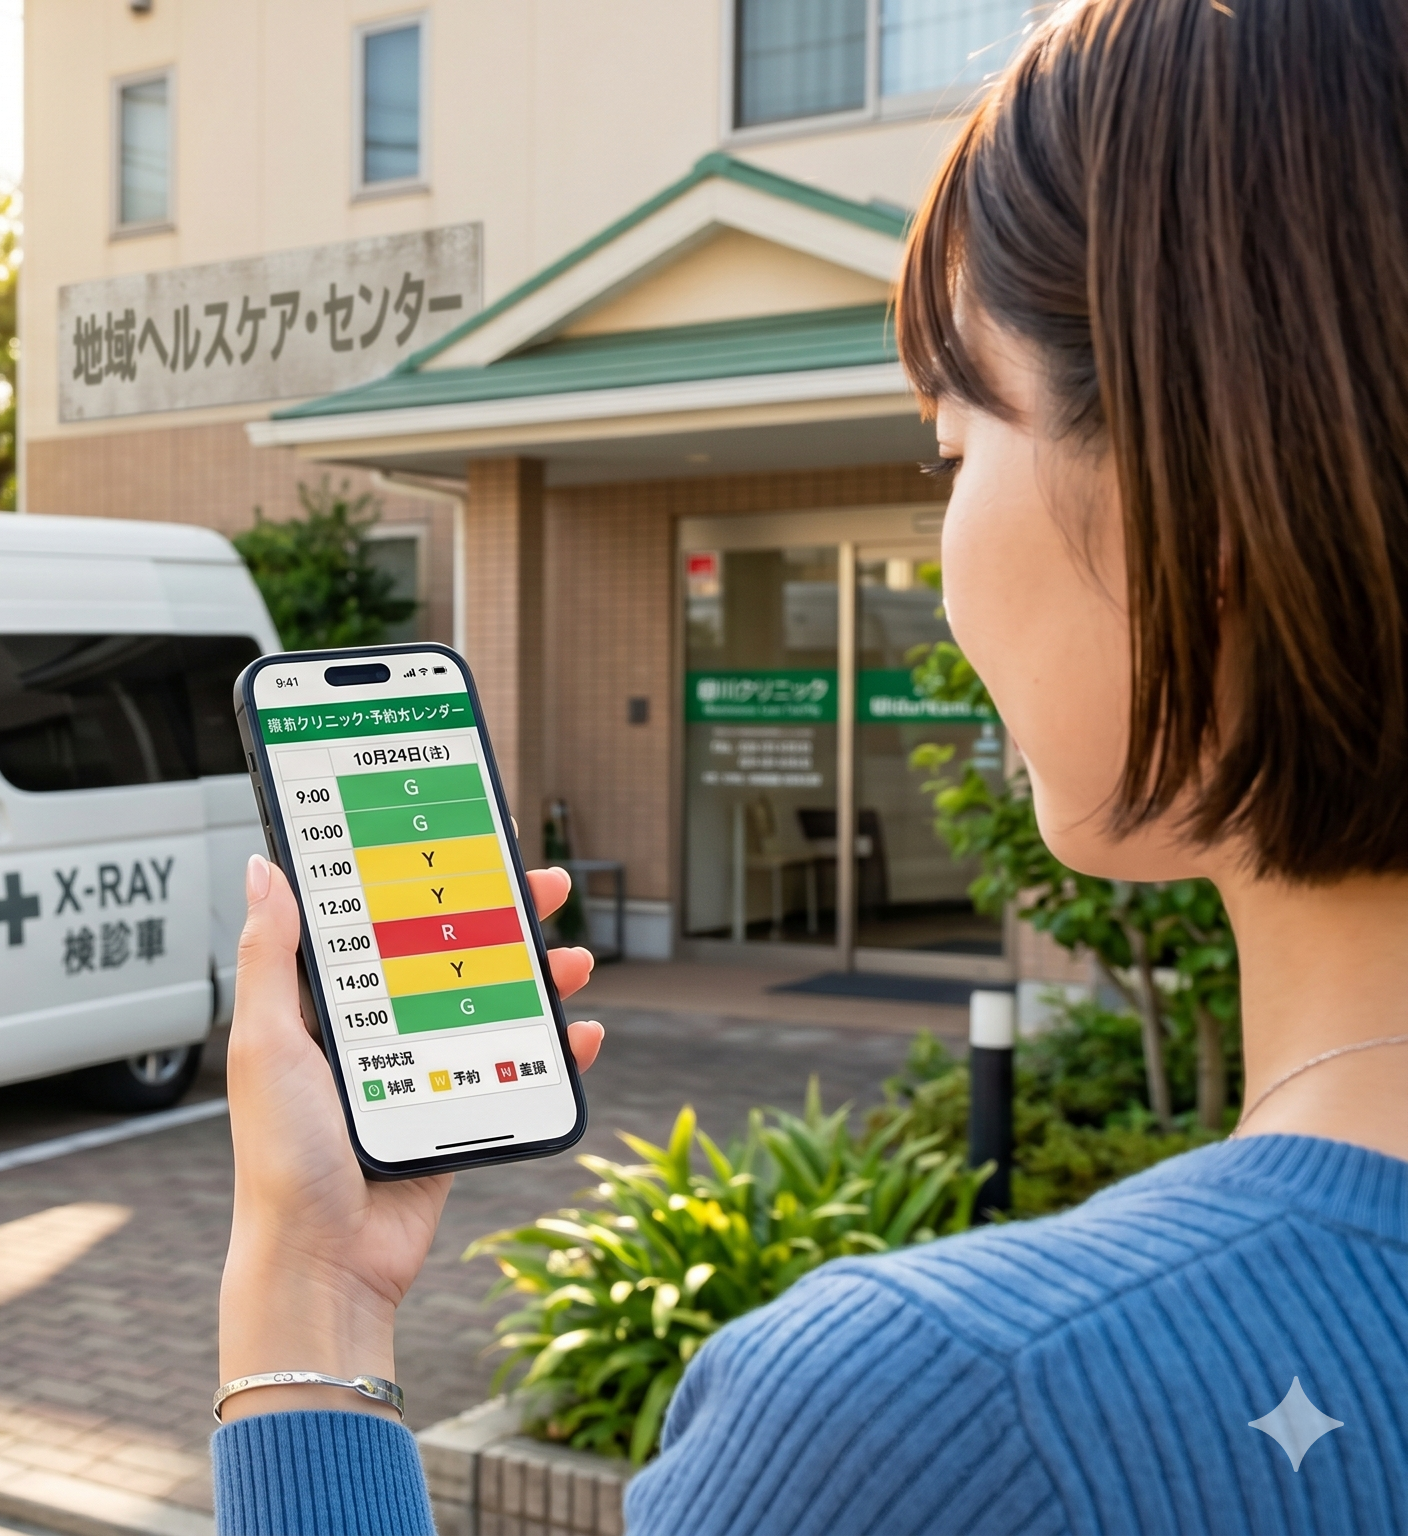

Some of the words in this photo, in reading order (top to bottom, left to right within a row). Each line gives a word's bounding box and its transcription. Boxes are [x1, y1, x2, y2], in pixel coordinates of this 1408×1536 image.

[72, 270, 462, 386] 地域ヘルスケア・センター
[275, 676, 299, 689] 9:41
[295, 788, 330, 805] 9:00
[403, 779, 419, 796] G
[301, 824, 343, 842] 10:00
[412, 815, 428, 832] G
[310, 861, 352, 879] 11:00
[421, 851, 435, 868] Y
[55, 857, 174, 915] X-RAY
[318, 897, 361, 916] 12:00
[430, 887, 444, 904] Y
[327, 935, 371, 953] 12:00
[441, 923, 457, 941] R
[336, 972, 379, 991] 14:00
[450, 960, 464, 978] Y
[345, 1010, 389, 1029] 15:00
[459, 998, 475, 1015] G
